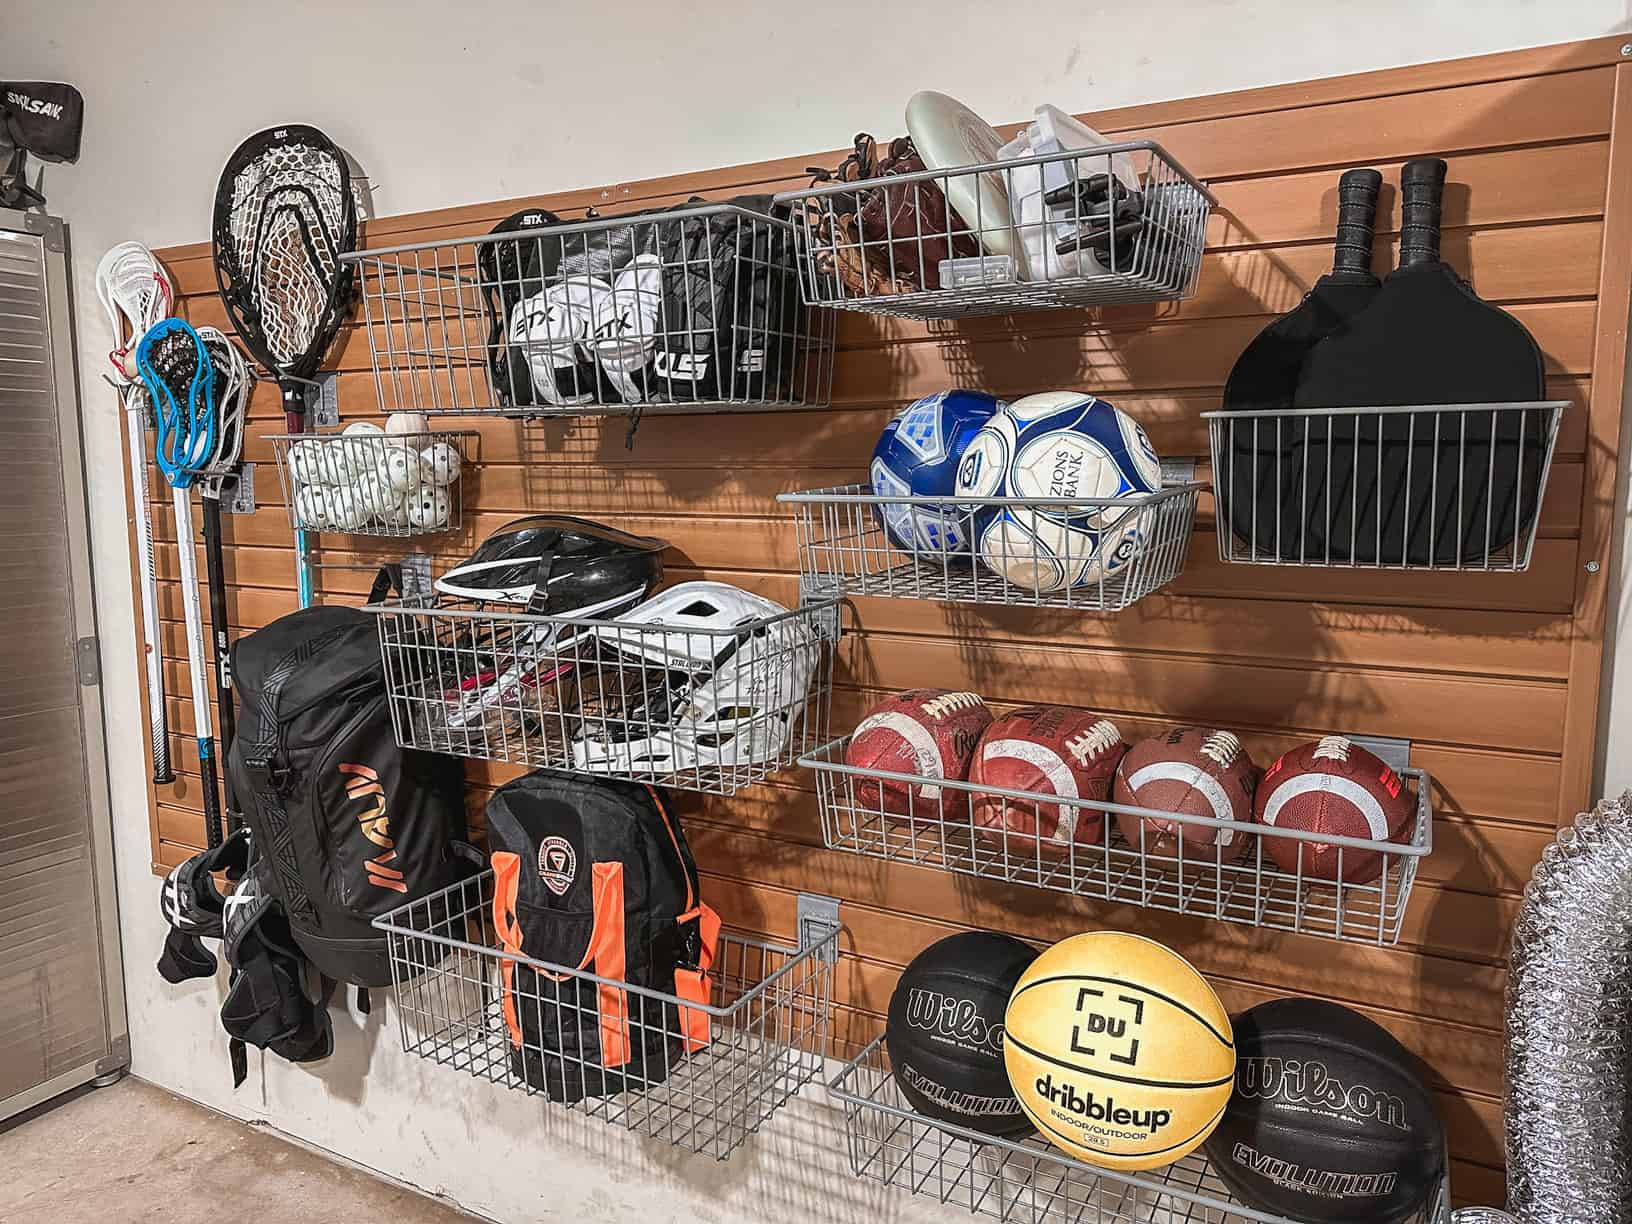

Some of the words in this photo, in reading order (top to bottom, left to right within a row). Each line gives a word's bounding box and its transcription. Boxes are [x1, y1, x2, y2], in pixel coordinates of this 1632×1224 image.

[523, 214, 543, 225] STX
[516, 306, 556, 337] STX
[1049, 450, 1068, 496] ZIONS
[907, 988, 1005, 1051] Wilso
[1087, 1013, 1126, 1038] DU
[1036, 1075, 1171, 1133] dribbleup
[1238, 1057, 1411, 1131] Wilson
[1050, 1108, 1148, 1140] INDOOR/OUTDOOR
[1232, 1142, 1398, 1197] EVOLUTION
